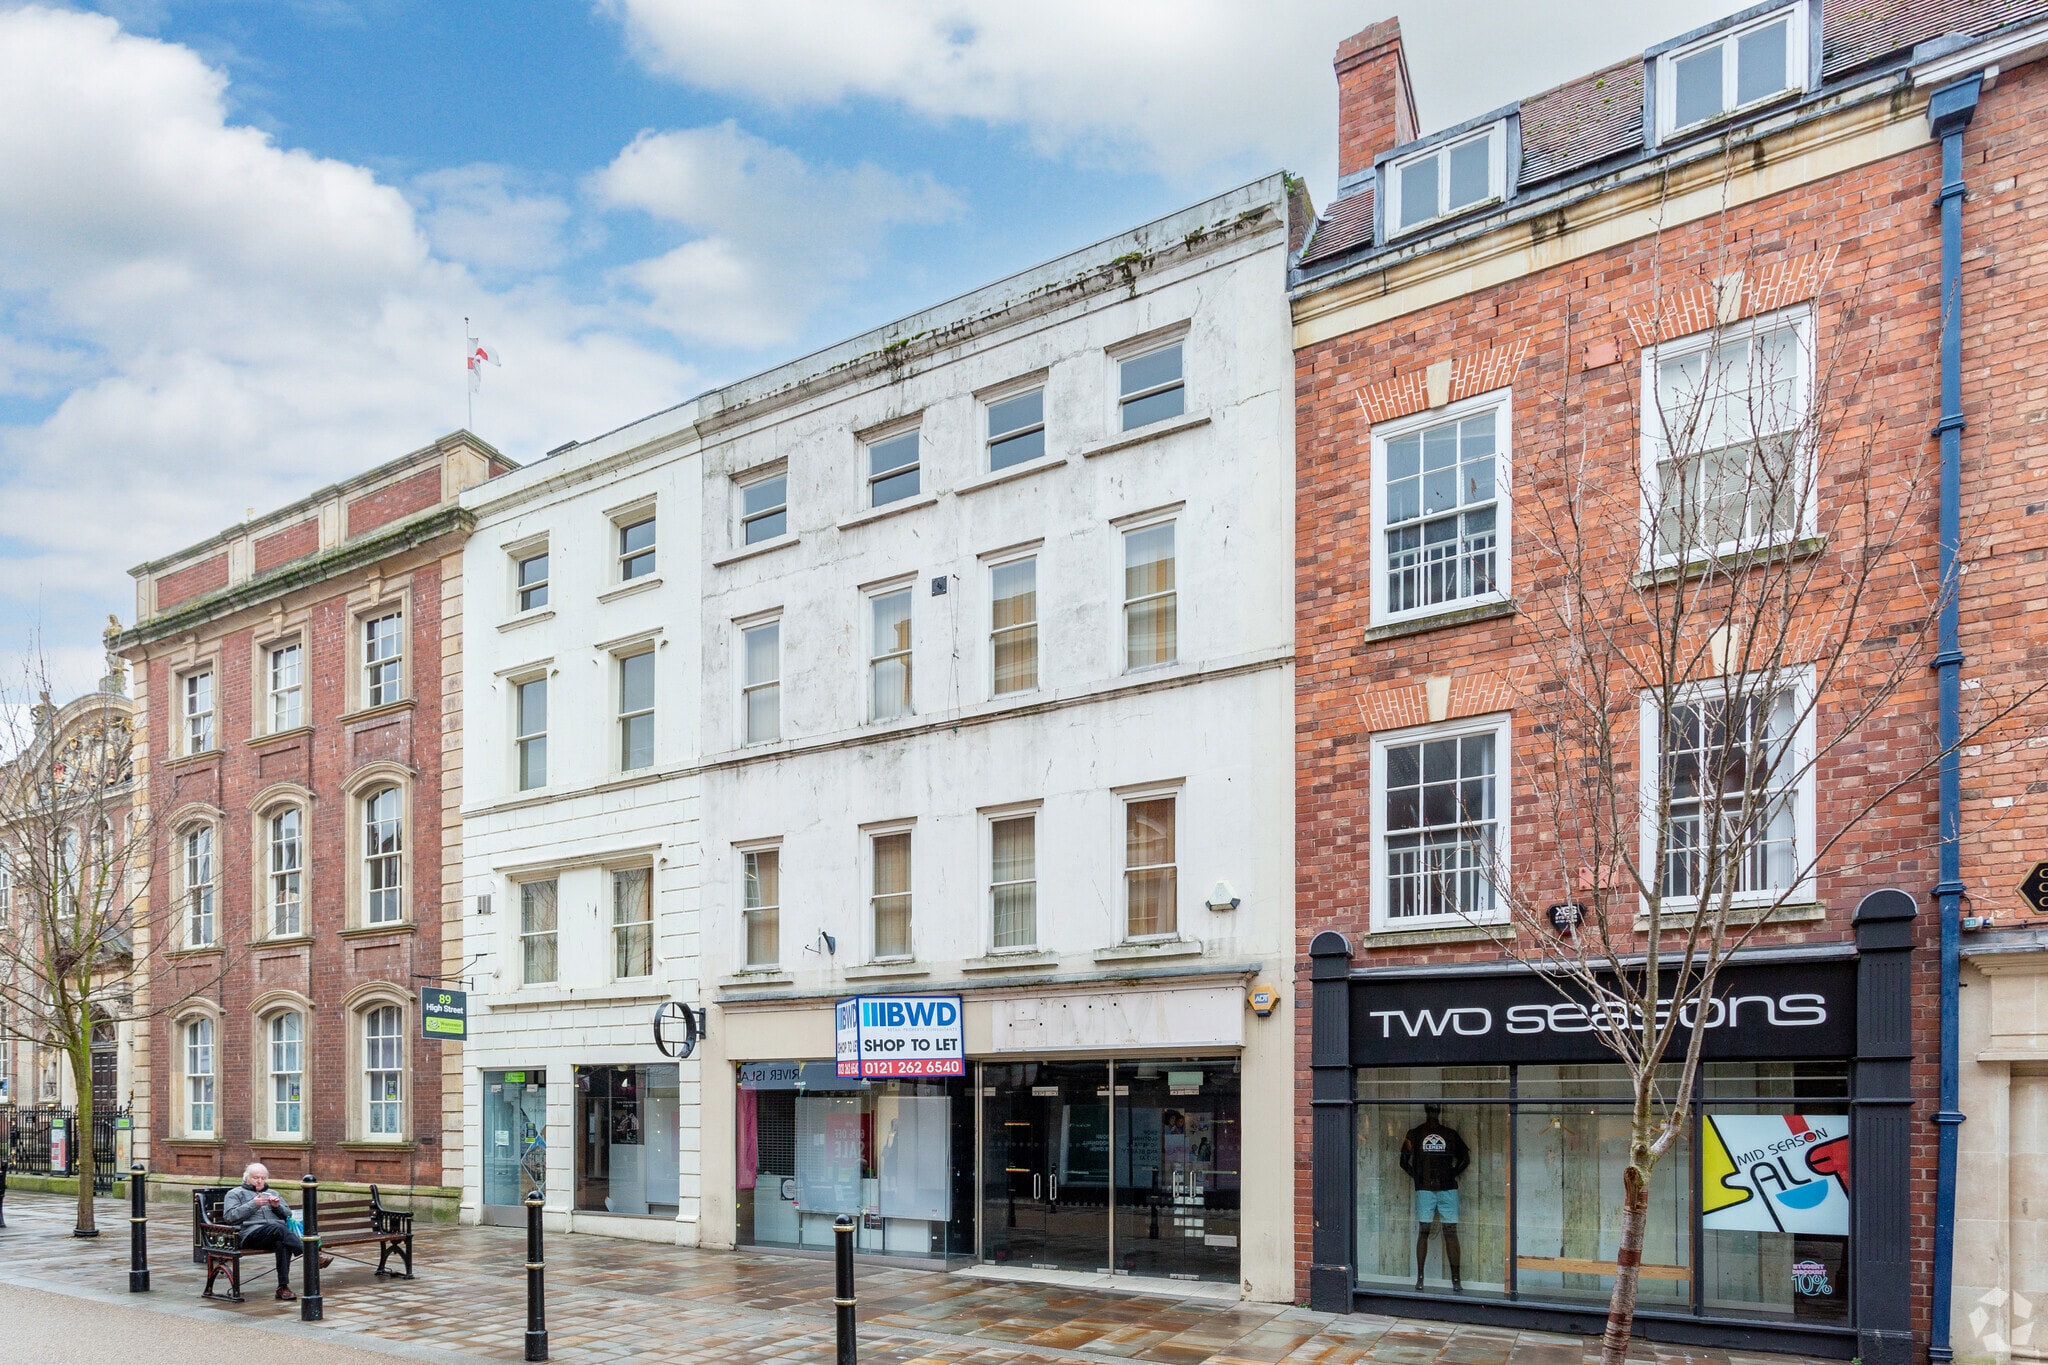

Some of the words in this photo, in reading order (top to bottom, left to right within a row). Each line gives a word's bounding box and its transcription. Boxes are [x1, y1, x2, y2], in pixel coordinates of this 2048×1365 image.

[439, 994, 452, 1004] 89
[1255, 994, 1269, 1002] ADT
[426, 1003, 443, 1013] High
[443, 1005, 464, 1014] Street
[1369, 1006, 1492, 1038] TWO
[864, 1039, 906, 1052] SHOP
[911, 1039, 931, 1051] TO
[936, 1038, 958, 1051] LET
[865, 1061, 893, 1075] 0121
[898, 1061, 922, 1074] 262
[926, 1061, 960, 1073] 6540
[1736, 1148, 1765, 1166] MID
[1767, 1127, 1829, 1156] SEASON
[1703, 1125, 1847, 1232] SALE
[1790, 1273, 1833, 1296] 10%
